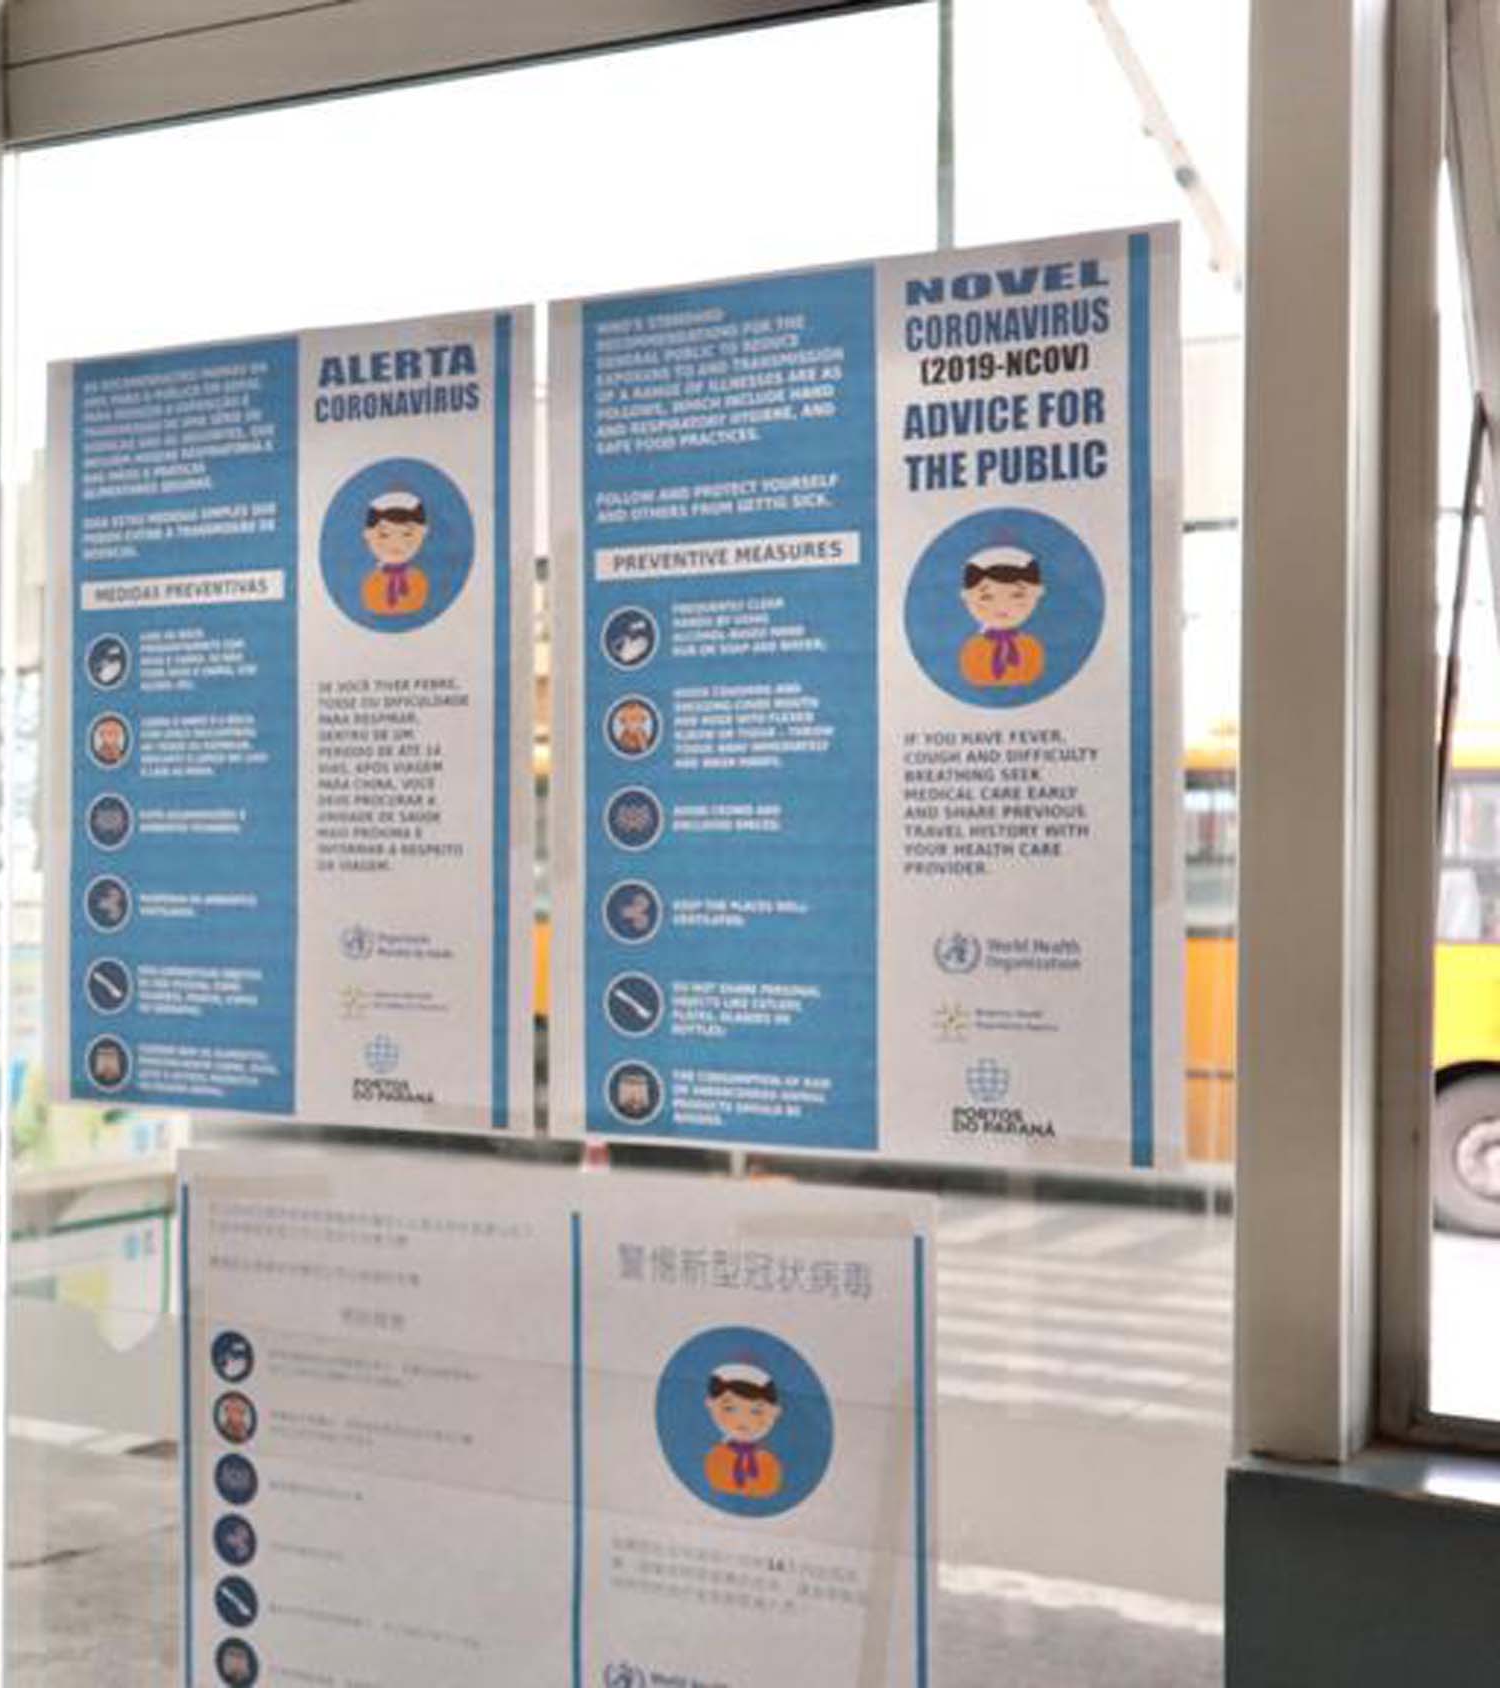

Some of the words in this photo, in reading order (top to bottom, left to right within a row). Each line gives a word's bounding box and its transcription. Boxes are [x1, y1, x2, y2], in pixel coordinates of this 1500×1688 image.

[904, 260, 1110, 305] NOVEL
[904, 296, 1110, 352] CORONAVIRUS
[317, 343, 478, 387] ALERTA
[920, 342, 1089, 387] (2019-NCOV)
[314, 383, 480, 424] CORONAVÍRUS
[903, 392, 1030, 441] ADVICE
[1038, 386, 1106, 429] FOR
[904, 453, 969, 492] THE
[974, 438, 1109, 487] PUBLIC
[612, 547, 730, 573] PREVENTIVE
[734, 539, 845, 563] MEASURES
[94, 584, 160, 603] MEDIDAS
[163, 577, 268, 600] PREVENTIVAS
[904, 732, 916, 746] IF
[925, 731, 958, 746] YOU
[961, 730, 1003, 746] HAVE
[904, 750, 961, 765] COUGH
[965, 750, 1000, 764] AND
[1005, 748, 1099, 764] DIFFICULTY
[904, 768, 995, 783] BREATHING
[1000, 767, 1040, 782] SEEK
[904, 787, 974, 801] MEDICAL
[980, 786, 1022, 800] CARE
[1027, 785, 1079, 800] EARLY
[904, 805, 939, 820] AND
[944, 804, 996, 819] SHARE
[1002, 803, 1087, 819] PREVIOUS
[904, 824, 964, 839] TRAVEL
[969, 823, 1039, 838] HISTORY
[1045, 823, 1090, 838] WITH
[904, 843, 948, 857] YOUR
[953, 843, 1015, 857] HEALTH
[1019, 842, 1061, 857] CARE
[952, 1105, 1024, 1122] PORTOS
[952, 1118, 979, 1133] DO
